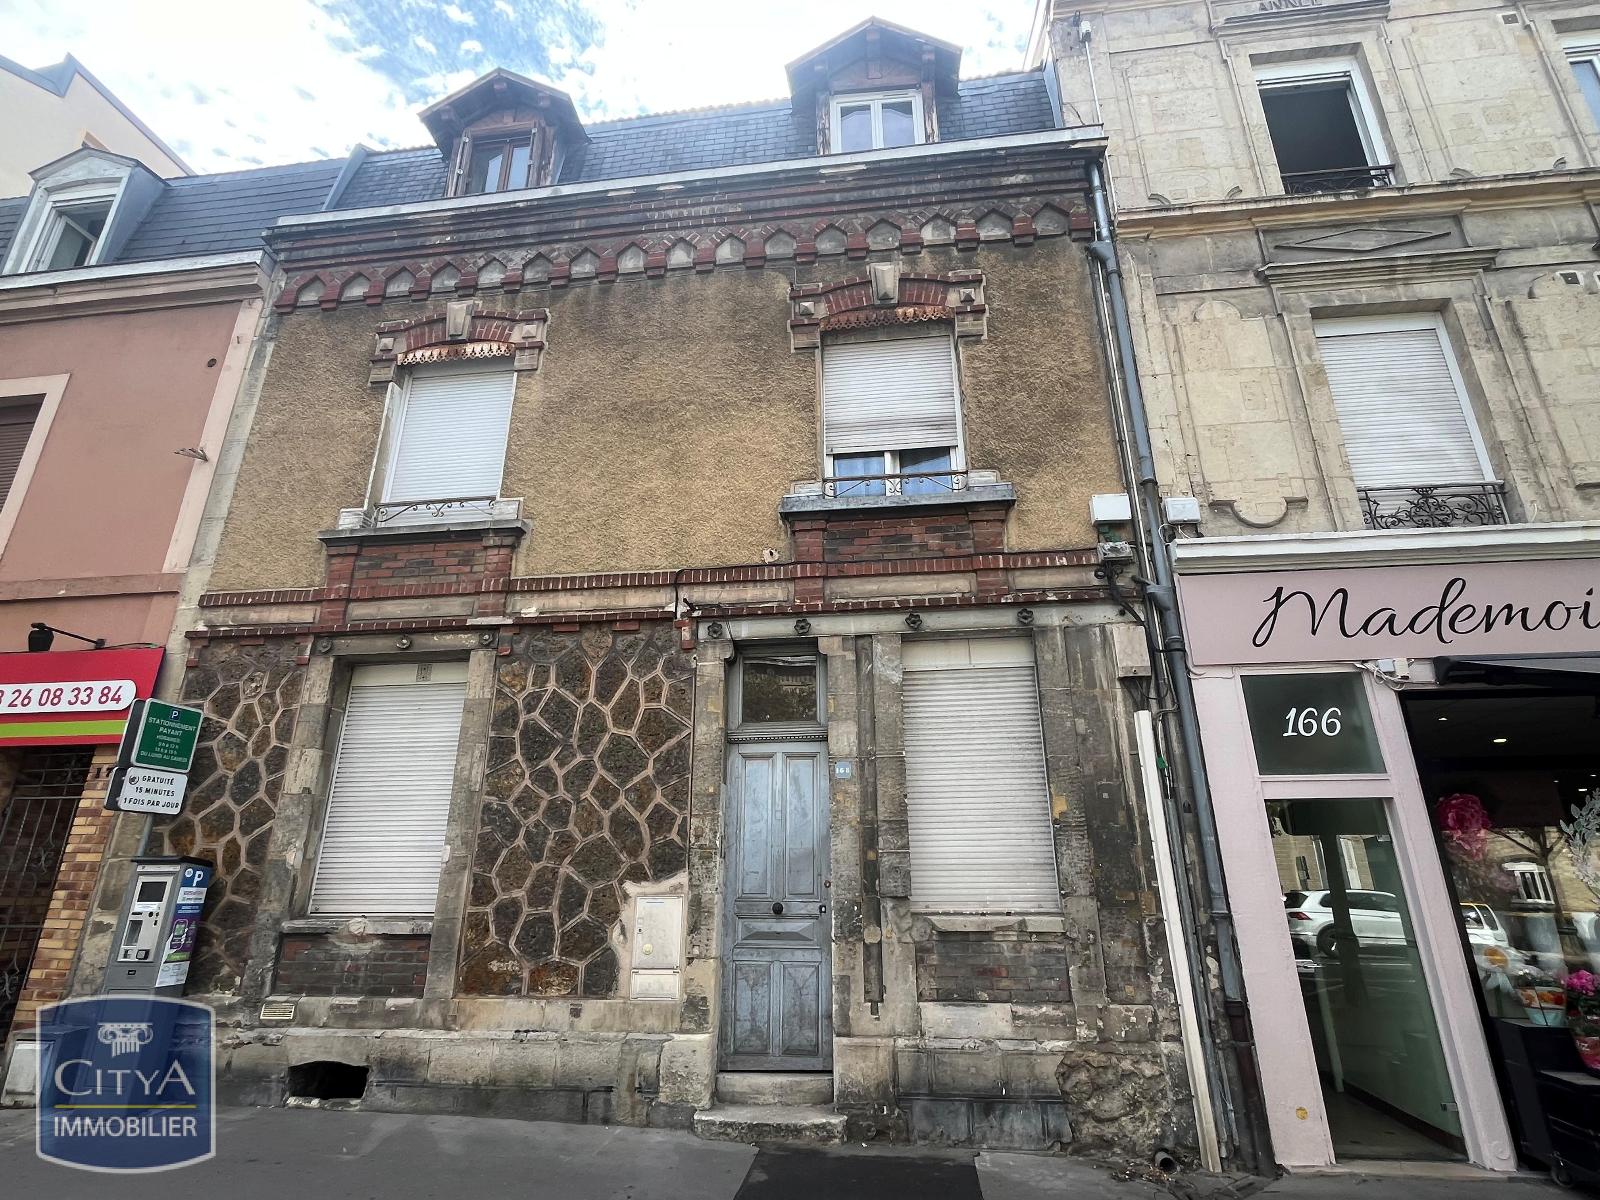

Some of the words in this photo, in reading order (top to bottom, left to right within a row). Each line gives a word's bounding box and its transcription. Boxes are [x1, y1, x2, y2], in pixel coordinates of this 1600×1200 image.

[1252, 577, 1600, 648] Mademoi
[8, 688, 33, 708] 26
[38, 687, 64, 707] 08
[67, 686, 94, 706] 33
[98, 685, 123, 705] 84
[171, 710, 179, 719] P
[1282, 706, 1343, 737] 166
[148, 716, 197, 732] STATIONNEMENT
[158, 726, 183, 737] PAYANT
[142, 775, 175, 786] GRATUITÉ
[135, 786, 143, 794] 15
[144, 787, 175, 797] MINUTES
[128, 797, 145, 806] FOIS
[161, 801, 180, 809] JOUR
[192, 870, 204, 887] P
